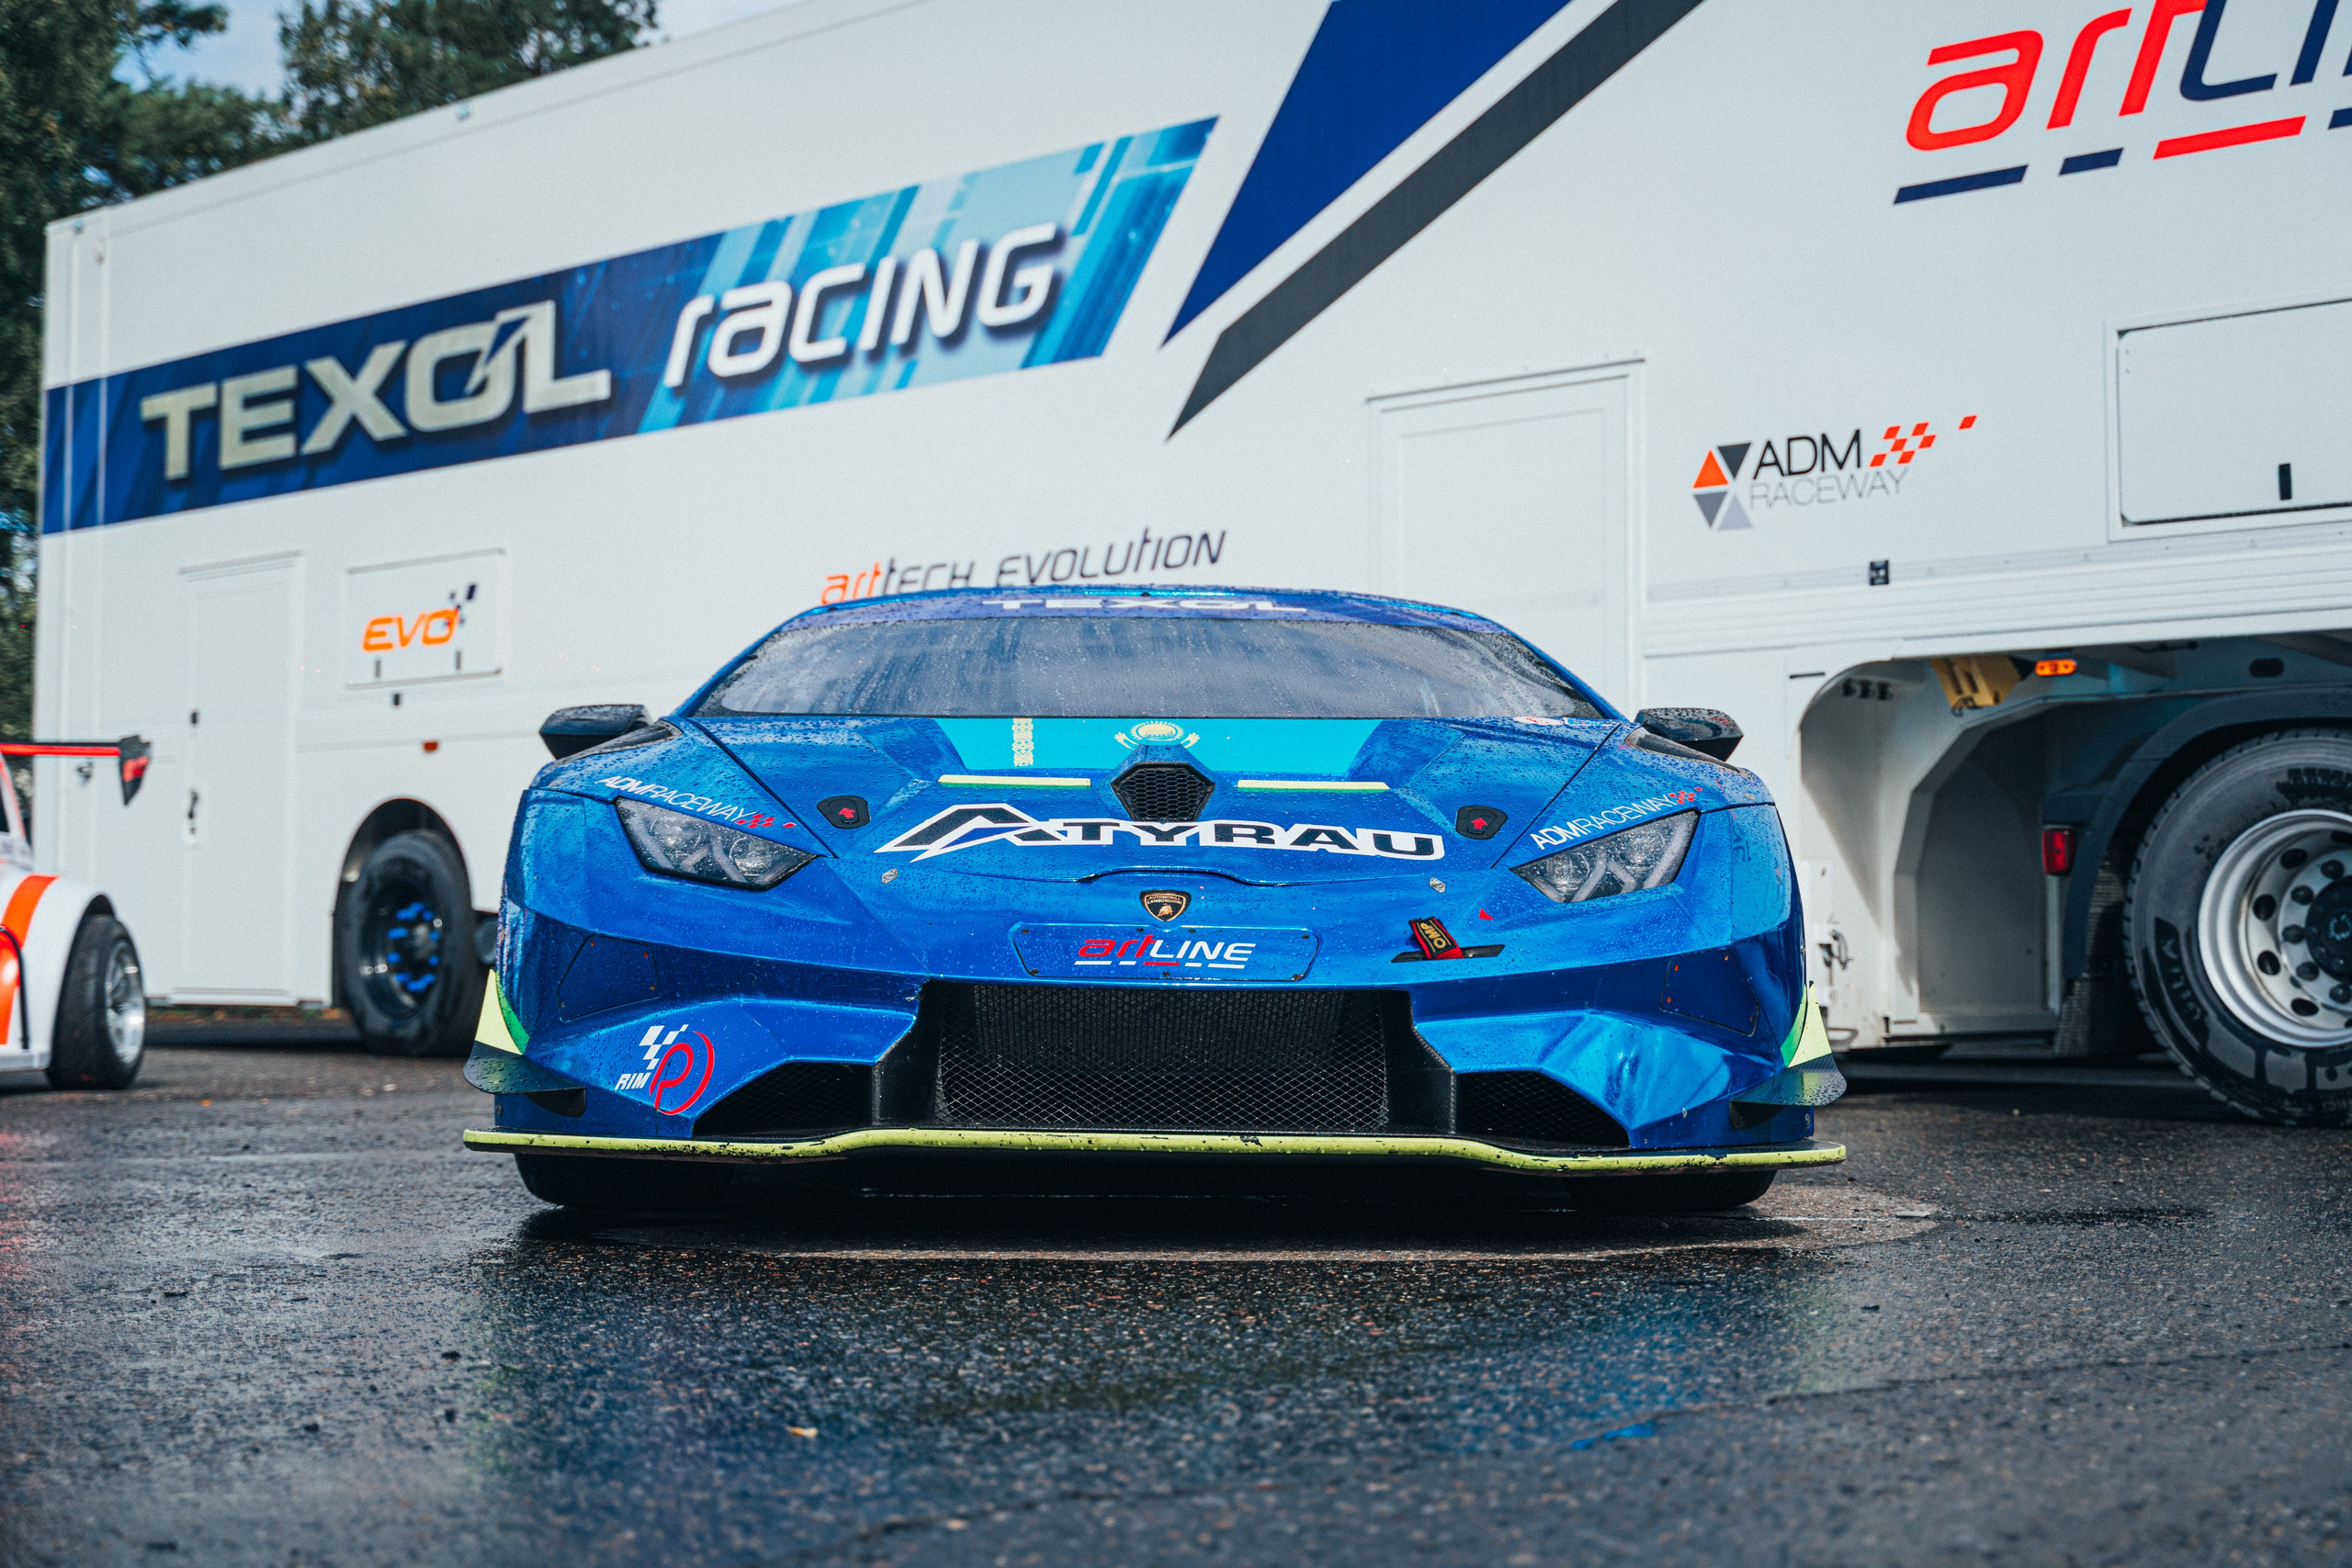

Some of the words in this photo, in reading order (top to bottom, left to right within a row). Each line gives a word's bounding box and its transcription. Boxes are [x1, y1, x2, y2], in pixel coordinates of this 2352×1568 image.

[1905, 0, 2352, 151] artLI
[141, 300, 611, 480] TEXOL
[1753, 428, 1860, 479] ADM
[1749, 467, 1908, 510] RACEWAY
[982, 598, 1307, 613] TEXOL
[362, 608, 458, 651] EVO
[1419, 921, 1447, 950] OMP
[614, 1072, 651, 1090] RIM
